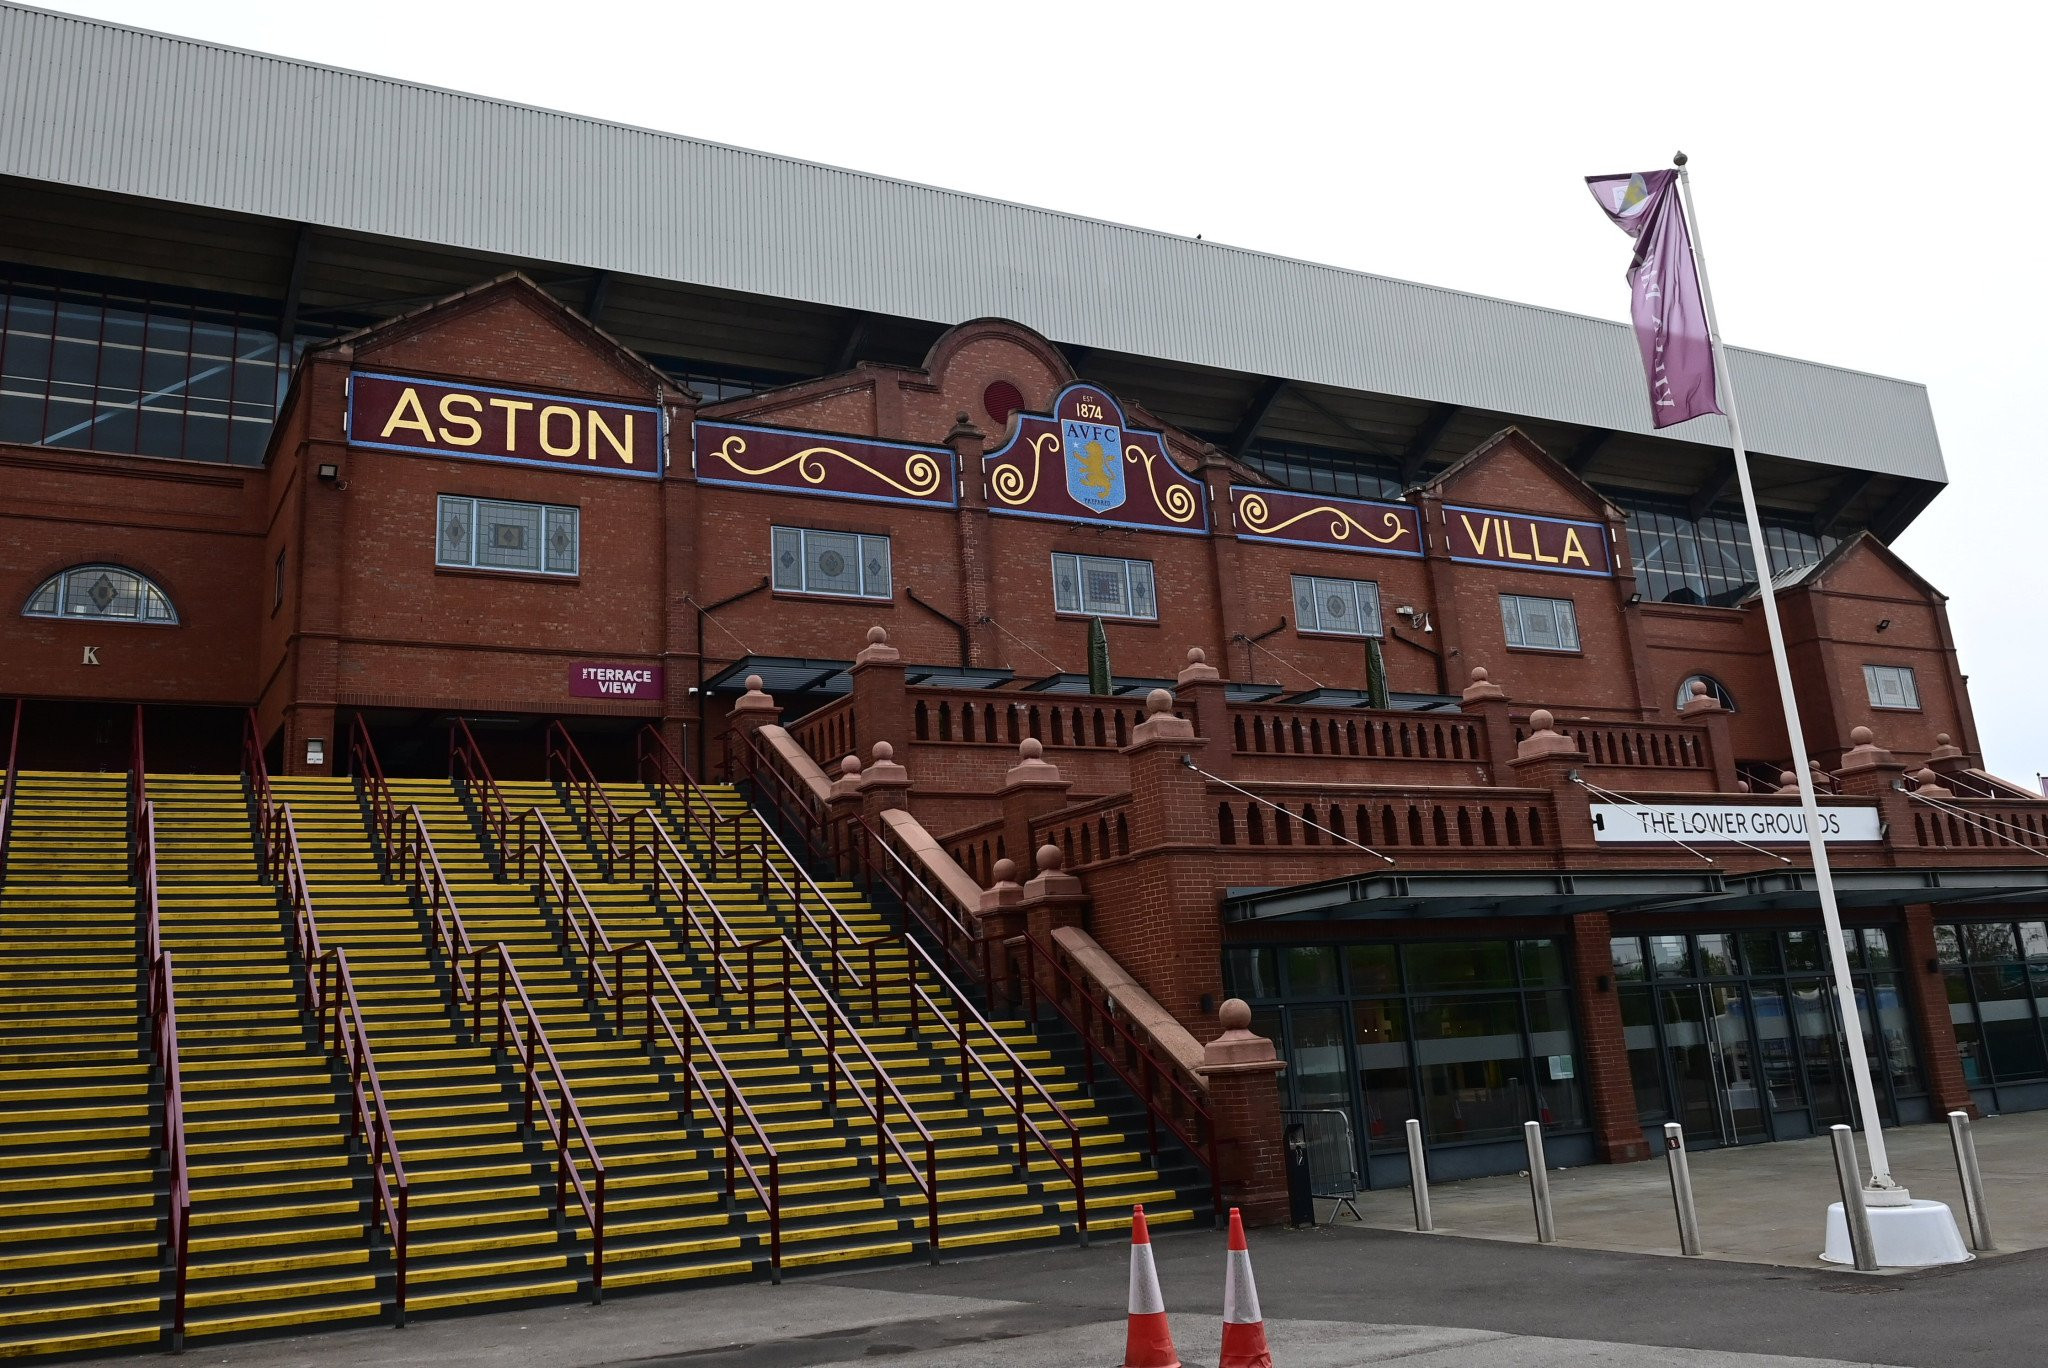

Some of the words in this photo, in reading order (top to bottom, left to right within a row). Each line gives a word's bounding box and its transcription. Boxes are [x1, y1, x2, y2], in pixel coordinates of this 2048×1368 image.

[1082, 395, 1094, 403] EST
[1076, 402, 1103, 420] 1874
[380, 387, 634, 464] ASTON
[1066, 423, 1116, 443] AVFC
[1460, 514, 1591, 567] VILLA
[81, 646, 101, 665] K
[588, 667, 652, 683] TERRACE
[598, 681, 637, 694] VIEW
[1637, 811, 1679, 834] THE
[1683, 812, 1749, 834] LOWER
